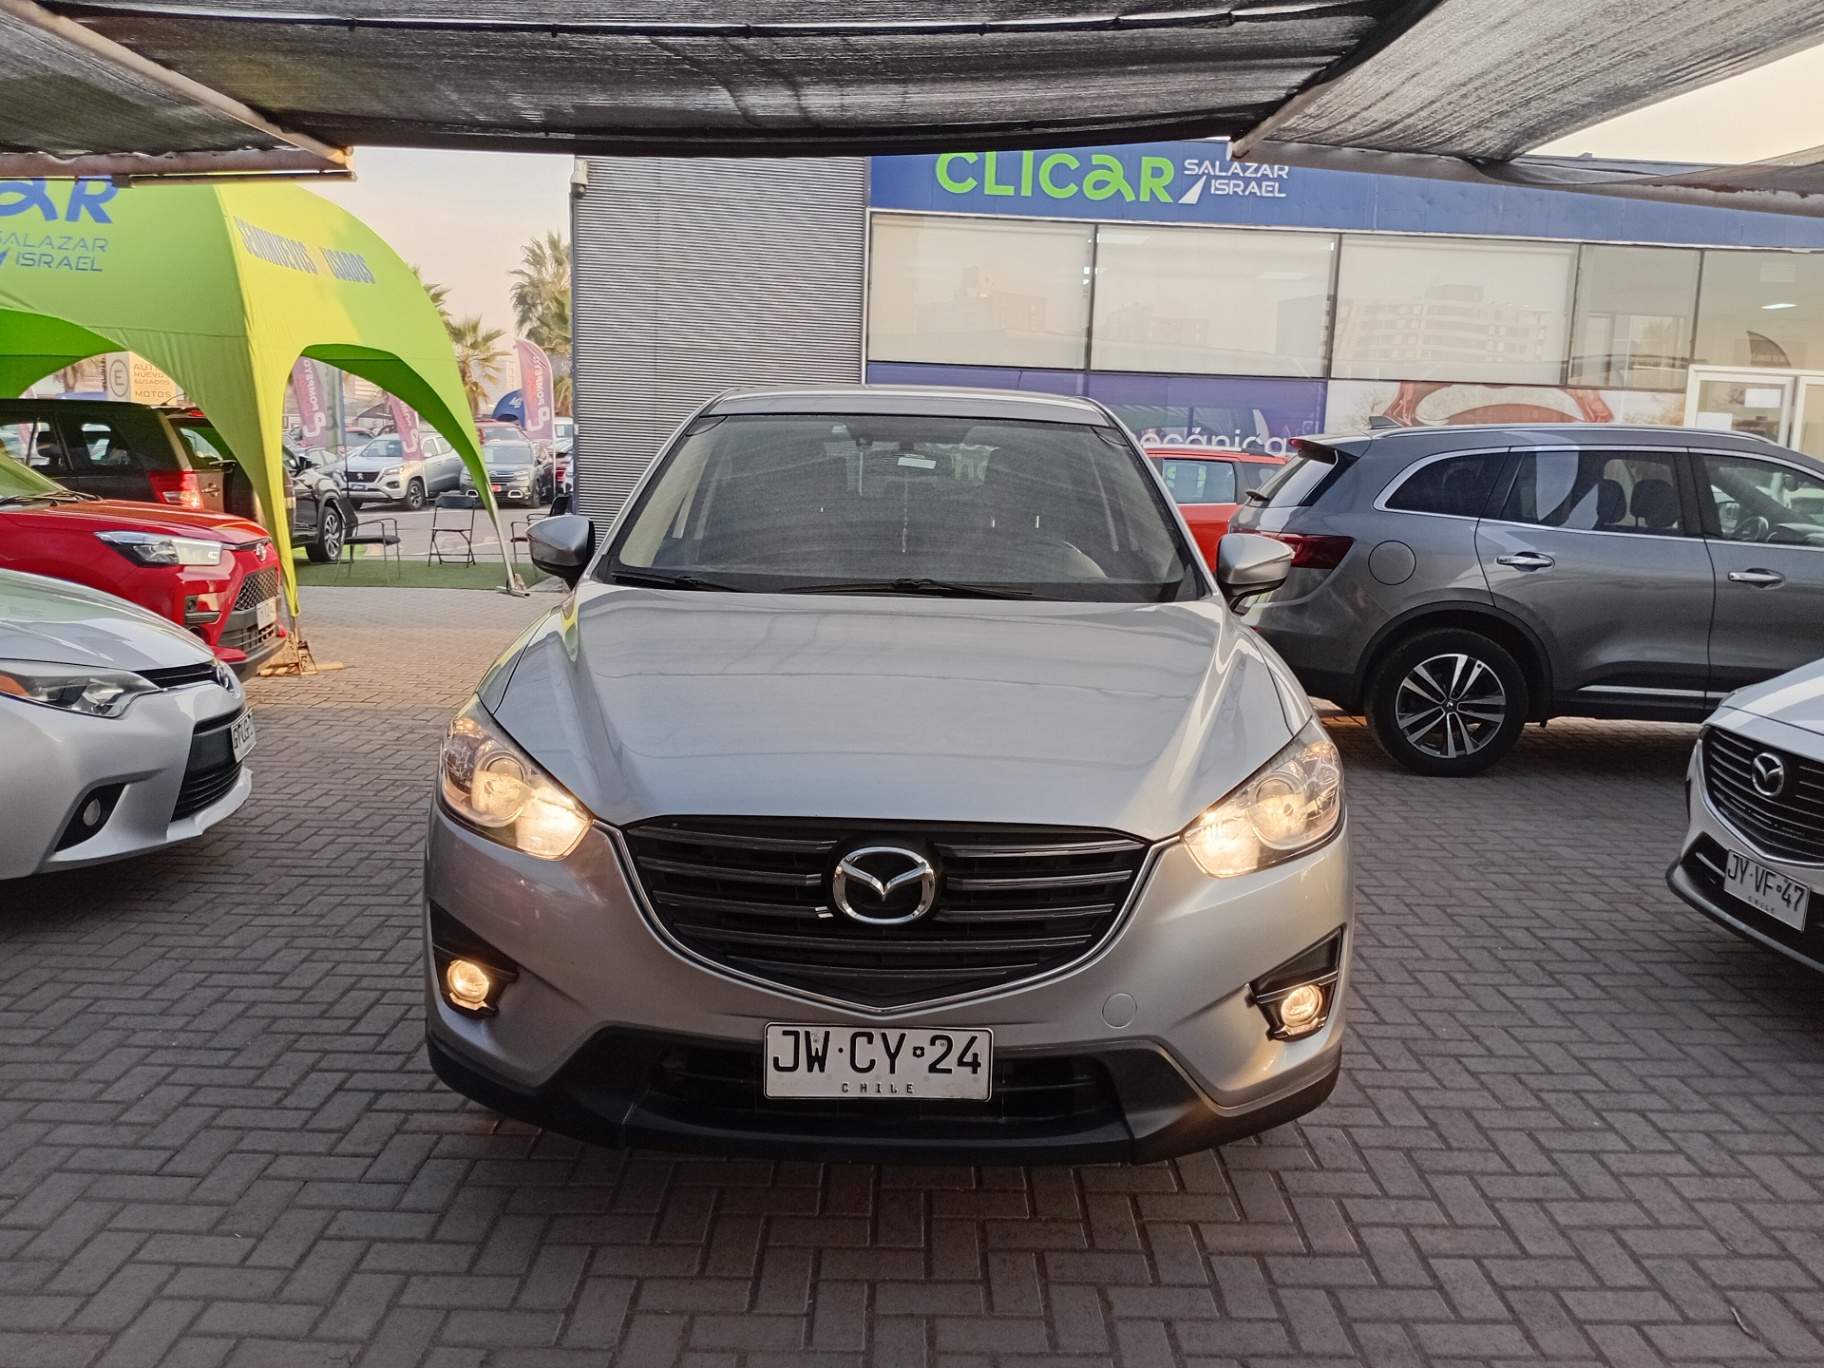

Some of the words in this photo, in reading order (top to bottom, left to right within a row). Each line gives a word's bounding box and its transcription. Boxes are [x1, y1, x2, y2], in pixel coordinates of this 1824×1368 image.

[1183, 159, 1289, 179] SALAZAR
[1210, 179, 1287, 197] ISRAEL
[0, 230, 109, 253] ALAZAR
[15, 251, 103, 272] ISRAEL
[1138, 426, 1288, 456] ecánica
[840, 1082, 914, 1095] CHILE
